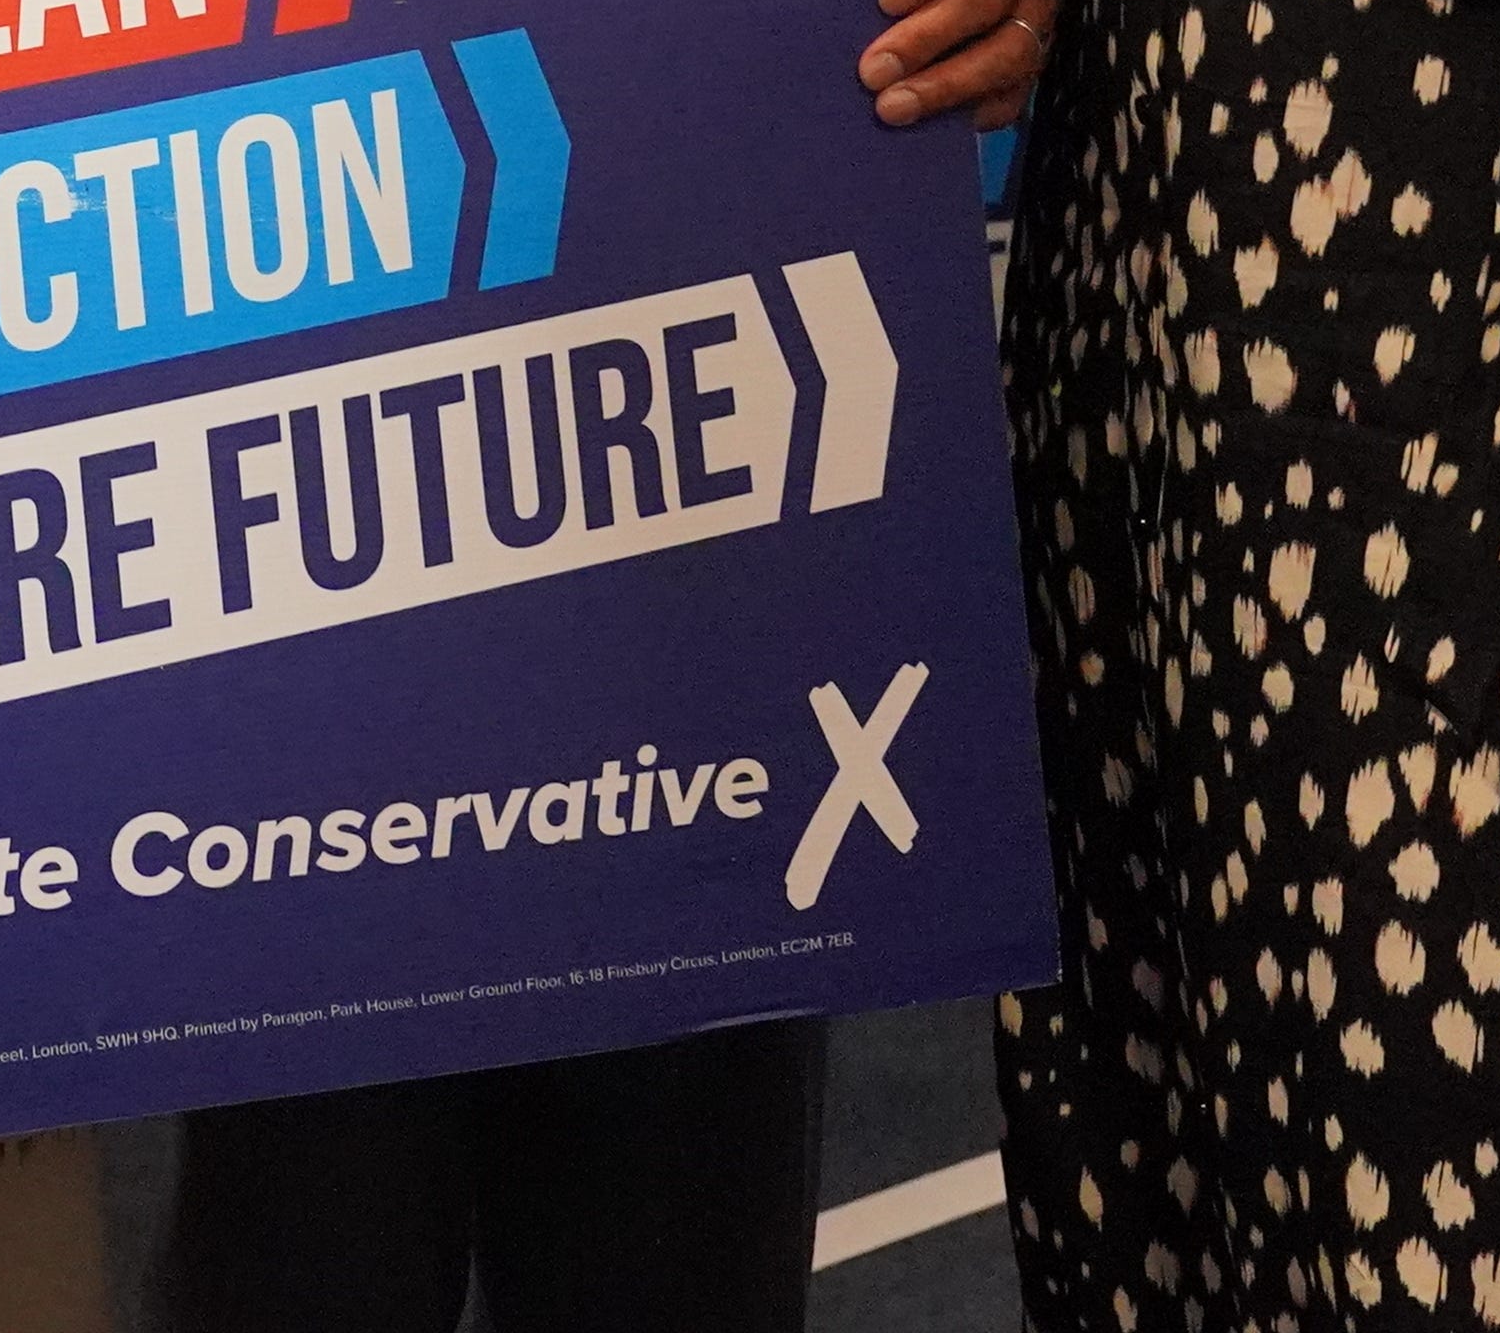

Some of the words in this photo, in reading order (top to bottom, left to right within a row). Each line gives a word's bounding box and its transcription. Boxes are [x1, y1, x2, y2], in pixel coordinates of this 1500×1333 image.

[209, 314, 757, 614] FUTURE
[109, 744, 771, 898] Conservative
[32, 1041, 92, 1059] London,
[96, 1031, 139, 1051] SW1H
[185, 1019, 237, 1038] Printed
[240, 1016, 259, 1034] by
[263, 1009, 328, 1030] Paragon,
[331, 1000, 363, 1018] Park
[421, 988, 465, 1006] Lower
[469, 979, 523, 999] Ground
[526, 974, 566, 992] Floor,
[569, 968, 604, 985] 16-18
[608, 960, 667, 982] Finsbury
[722, 946, 778, 964] London,
[781, 936, 824, 955] EC2M
